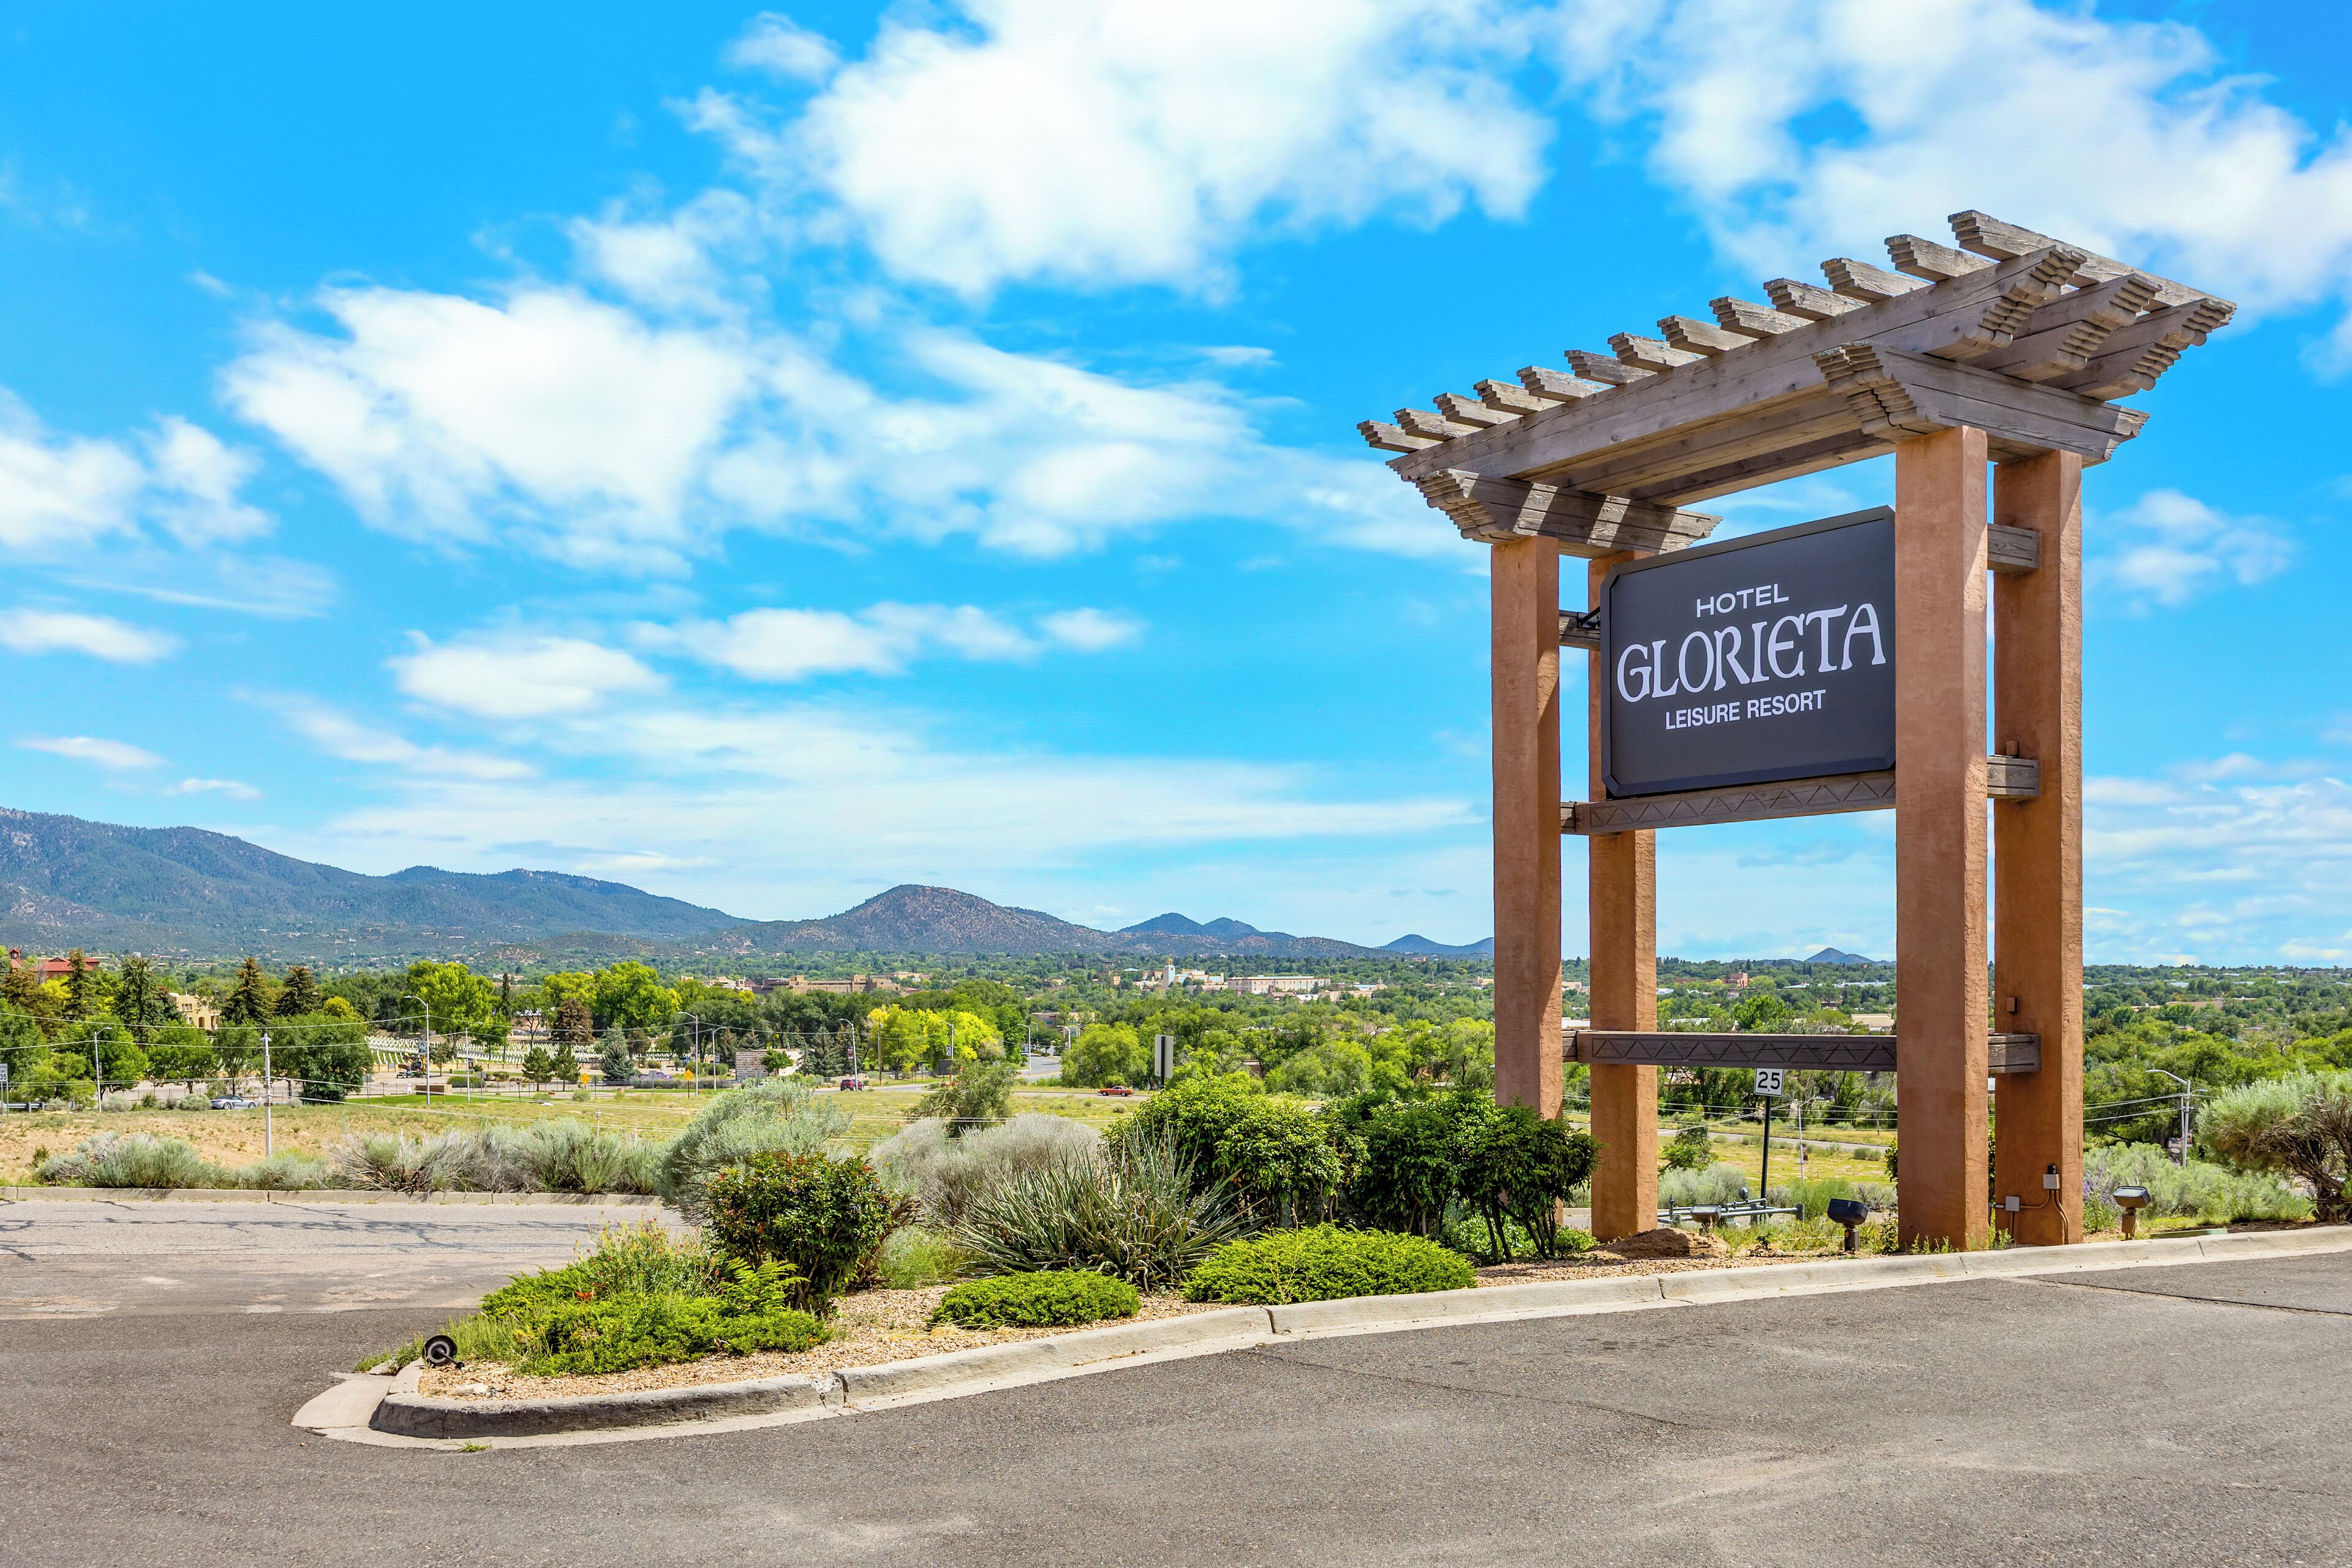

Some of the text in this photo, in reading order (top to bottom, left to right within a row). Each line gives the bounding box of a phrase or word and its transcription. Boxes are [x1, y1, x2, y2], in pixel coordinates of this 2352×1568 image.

[1696, 583, 1790, 618] HOTEL
[1616, 603, 1887, 703] GLORIETA
[1665, 689, 1826, 730] LEISURE RESORT
[1757, 1071, 1780, 1090] 25
